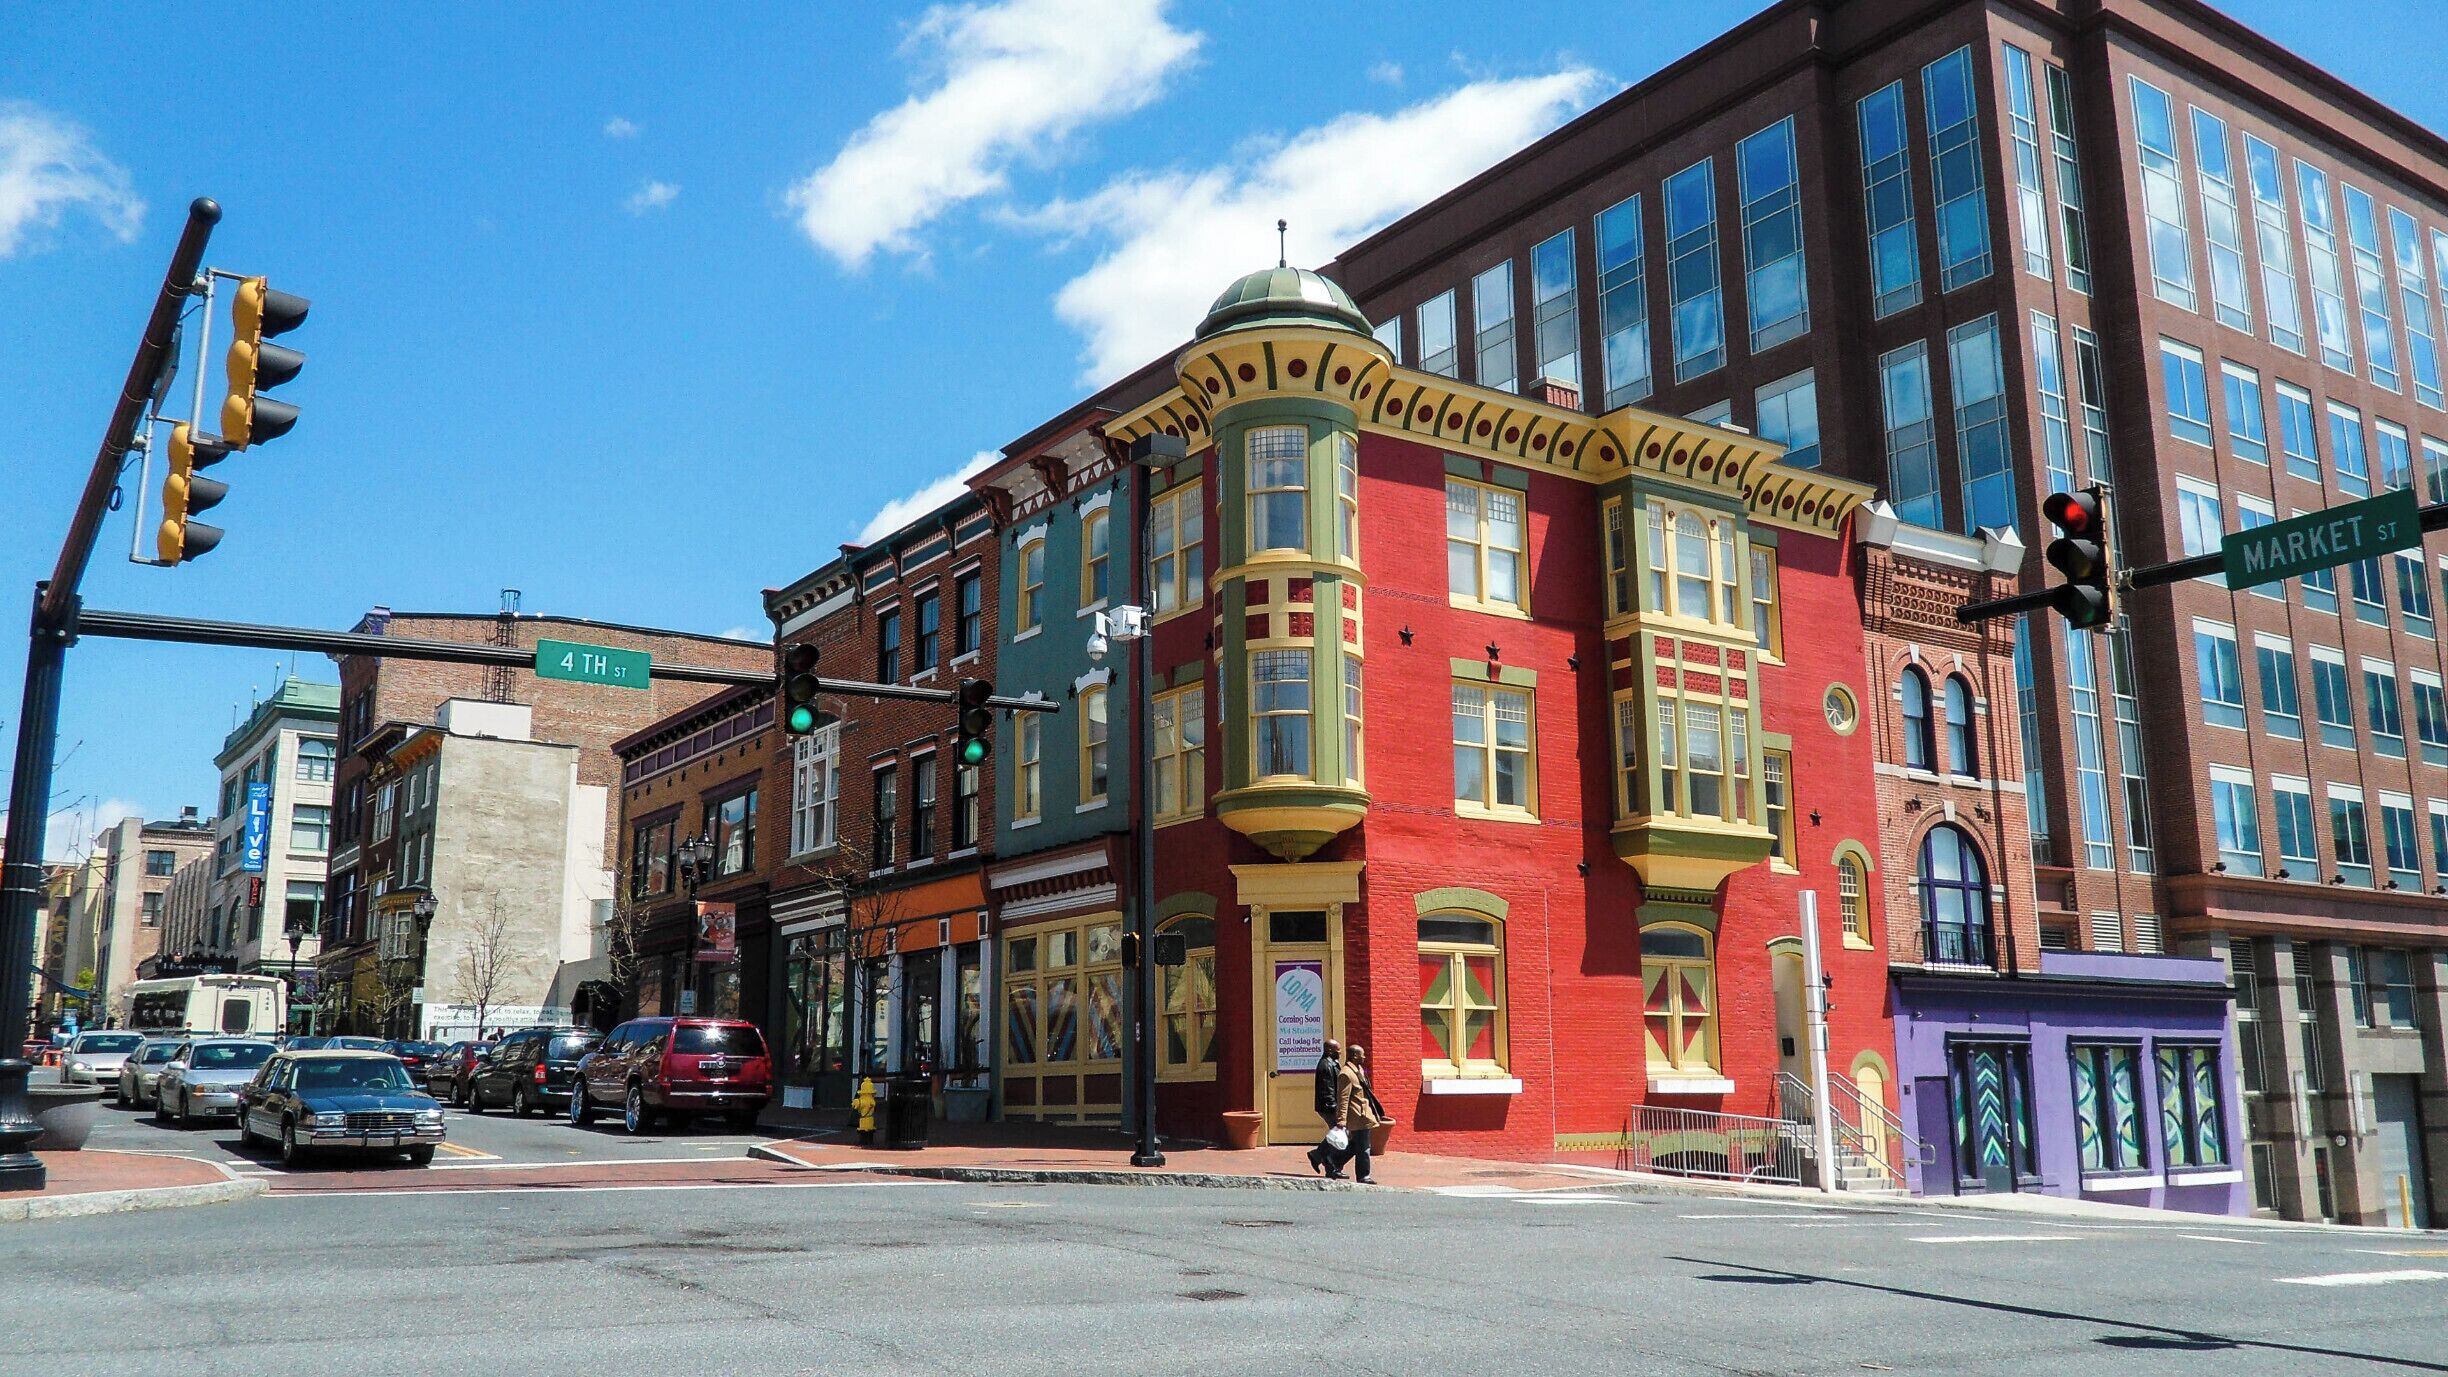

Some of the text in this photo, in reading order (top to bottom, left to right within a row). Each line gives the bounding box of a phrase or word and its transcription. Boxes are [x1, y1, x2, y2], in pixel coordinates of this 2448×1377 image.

[2242, 515, 2398, 574] MARKET ST
[560, 651, 627, 678] 4 TH ST
[1278, 1014, 1321, 1025] Coming Soon
[1293, 1038, 1311, 1047] today
[1279, 1046, 1322, 1055] appointments
